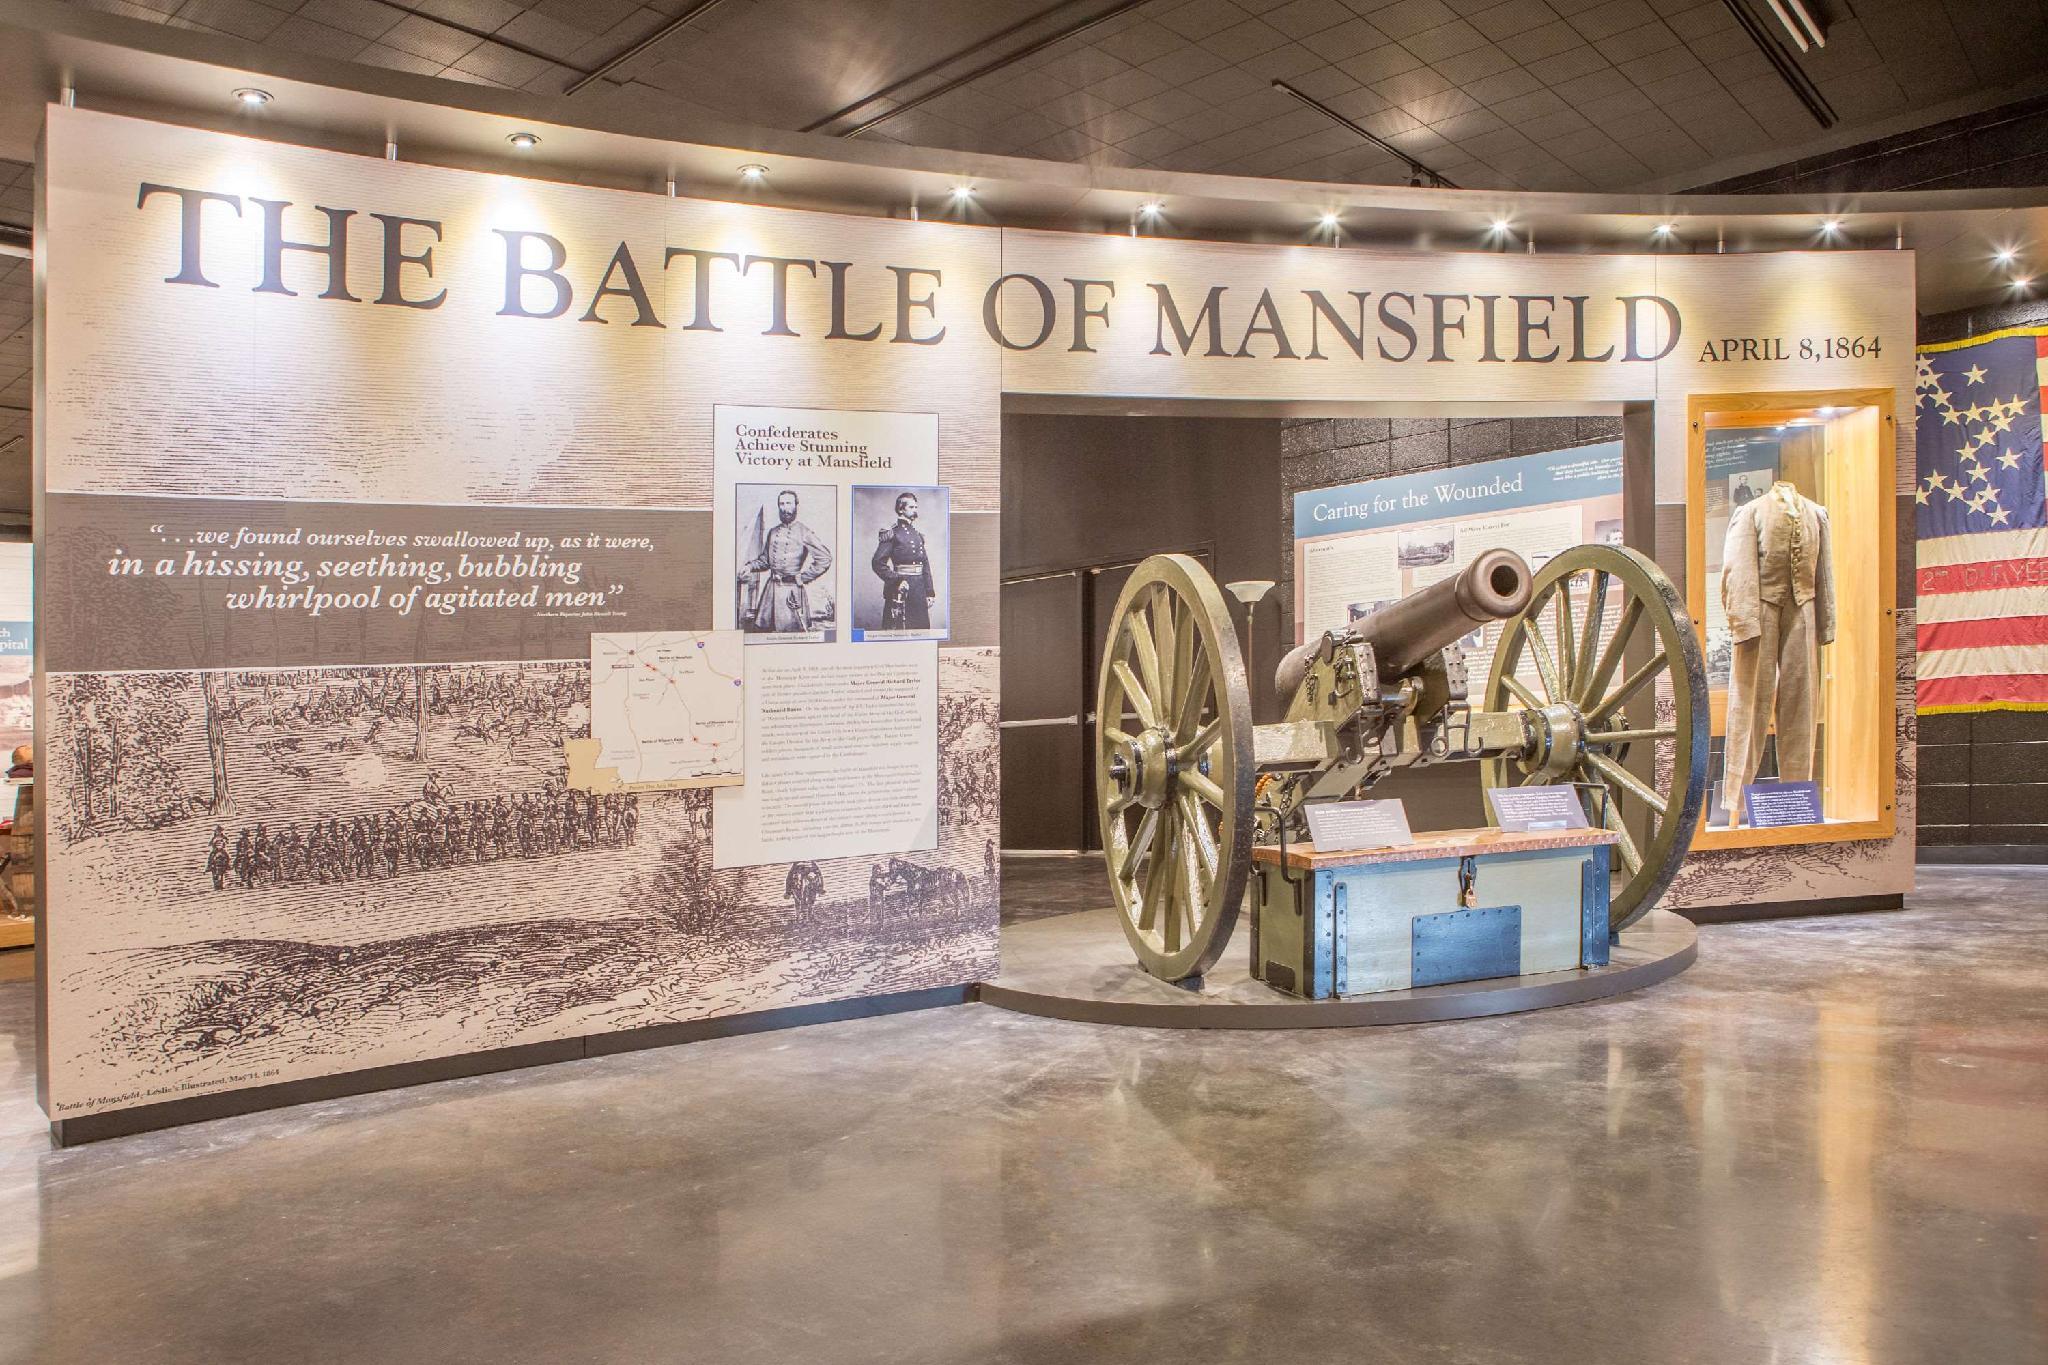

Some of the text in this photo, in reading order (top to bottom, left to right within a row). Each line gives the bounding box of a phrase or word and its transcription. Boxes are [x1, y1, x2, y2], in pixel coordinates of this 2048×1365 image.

[136, 182, 1683, 364] THE BATTLE OF MANSFIELD
[1698, 338, 1790, 362] APRIL
[735, 424, 839, 441] Confederates
[735, 438, 868, 456] Achieve Stunning
[735, 452, 893, 470] Victory at Mansfield
[1313, 471, 1523, 520] Caring for the Wounded
[229, 525, 301, 549] found
[306, 530, 407, 548] ourselves
[412, 531, 520, 549] swallowed
[524, 534, 556, 552] up,
[560, 535, 583, 549] as
[585, 531, 601, 549] it
[604, 533, 655, 552] were,
[108, 551, 583, 586] in a hissing, seething, bubbling
[225, 585, 380, 617] whirlpool
[388, 584, 418, 616] of
[424, 585, 538, 615] agitated
